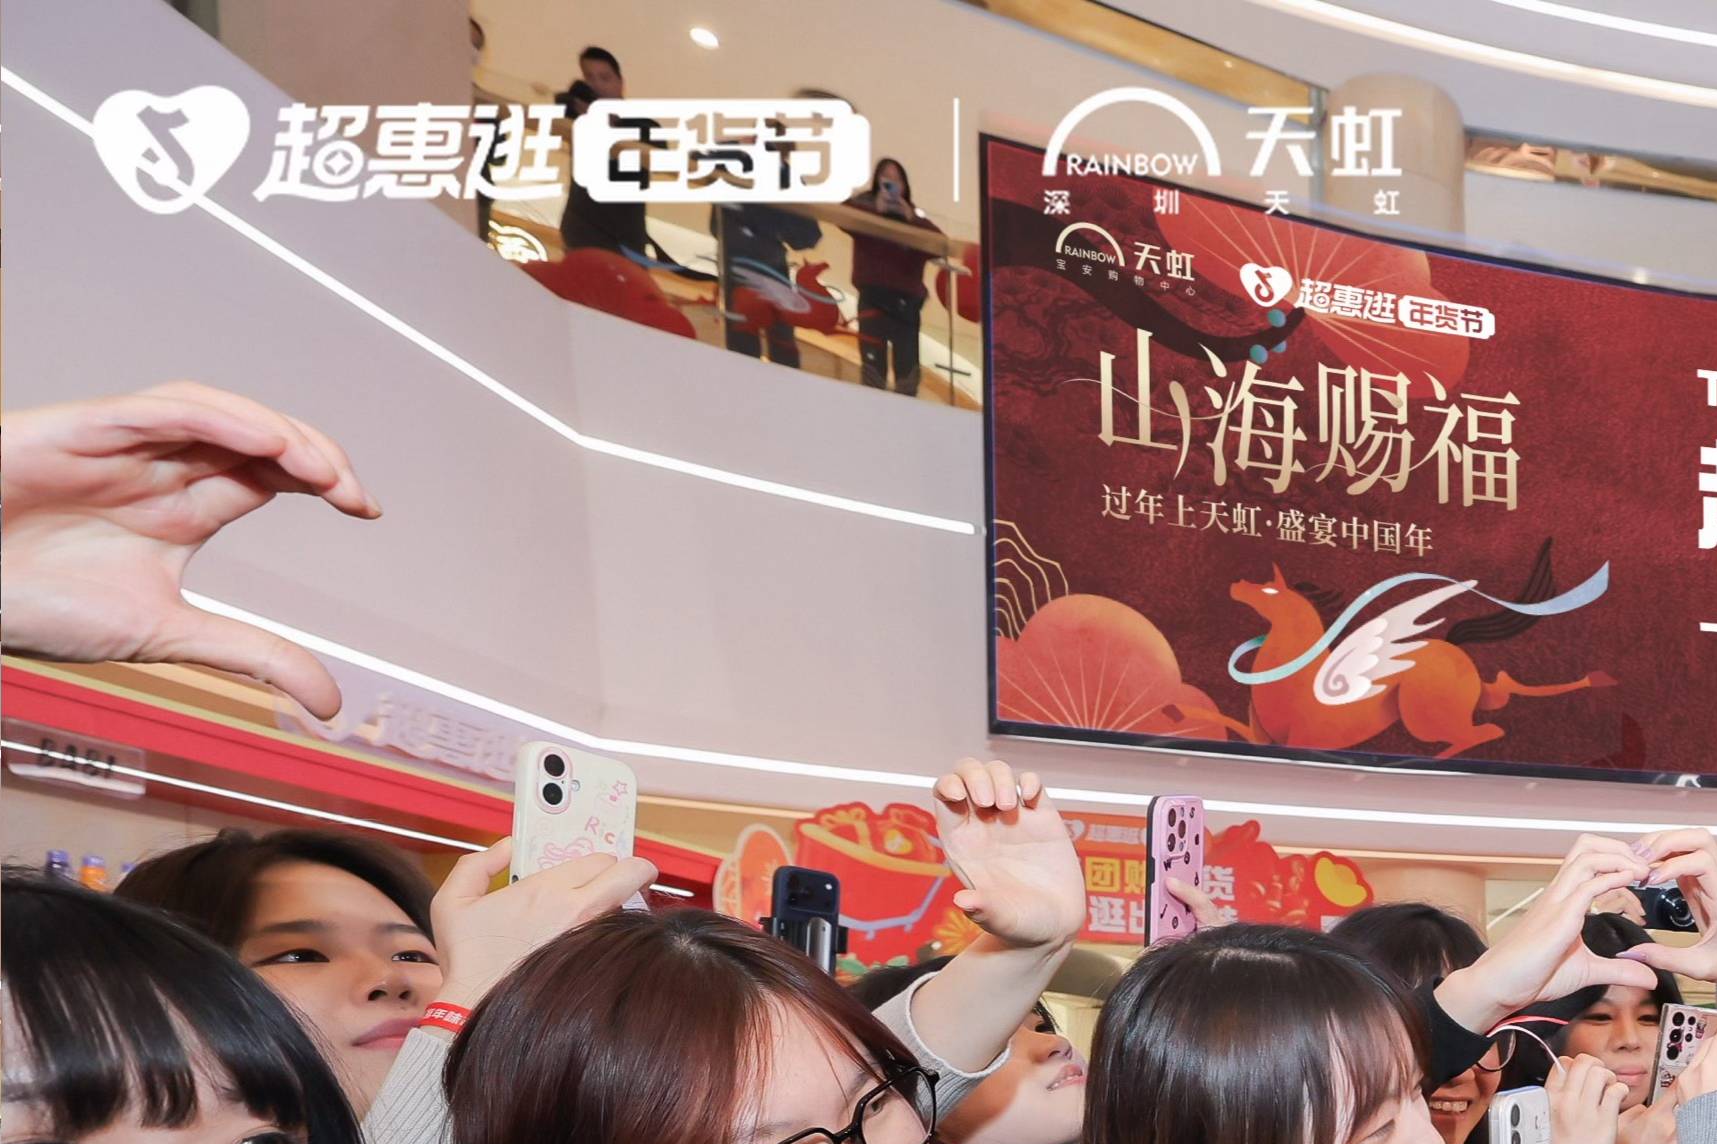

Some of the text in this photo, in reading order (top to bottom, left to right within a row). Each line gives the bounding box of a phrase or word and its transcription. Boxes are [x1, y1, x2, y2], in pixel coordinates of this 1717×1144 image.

[1065, 246, 1117, 266] RAINBOW
[1134, 242, 1196, 281] 天虹
[1056, 259, 1197, 296] 宝安购物中心
[1296, 279, 1397, 324] 超惠逛
[1097, 328, 1521, 512] 山海赐福
[1101, 484, 1434, 557] 过年上天虹·盛宴中国年
